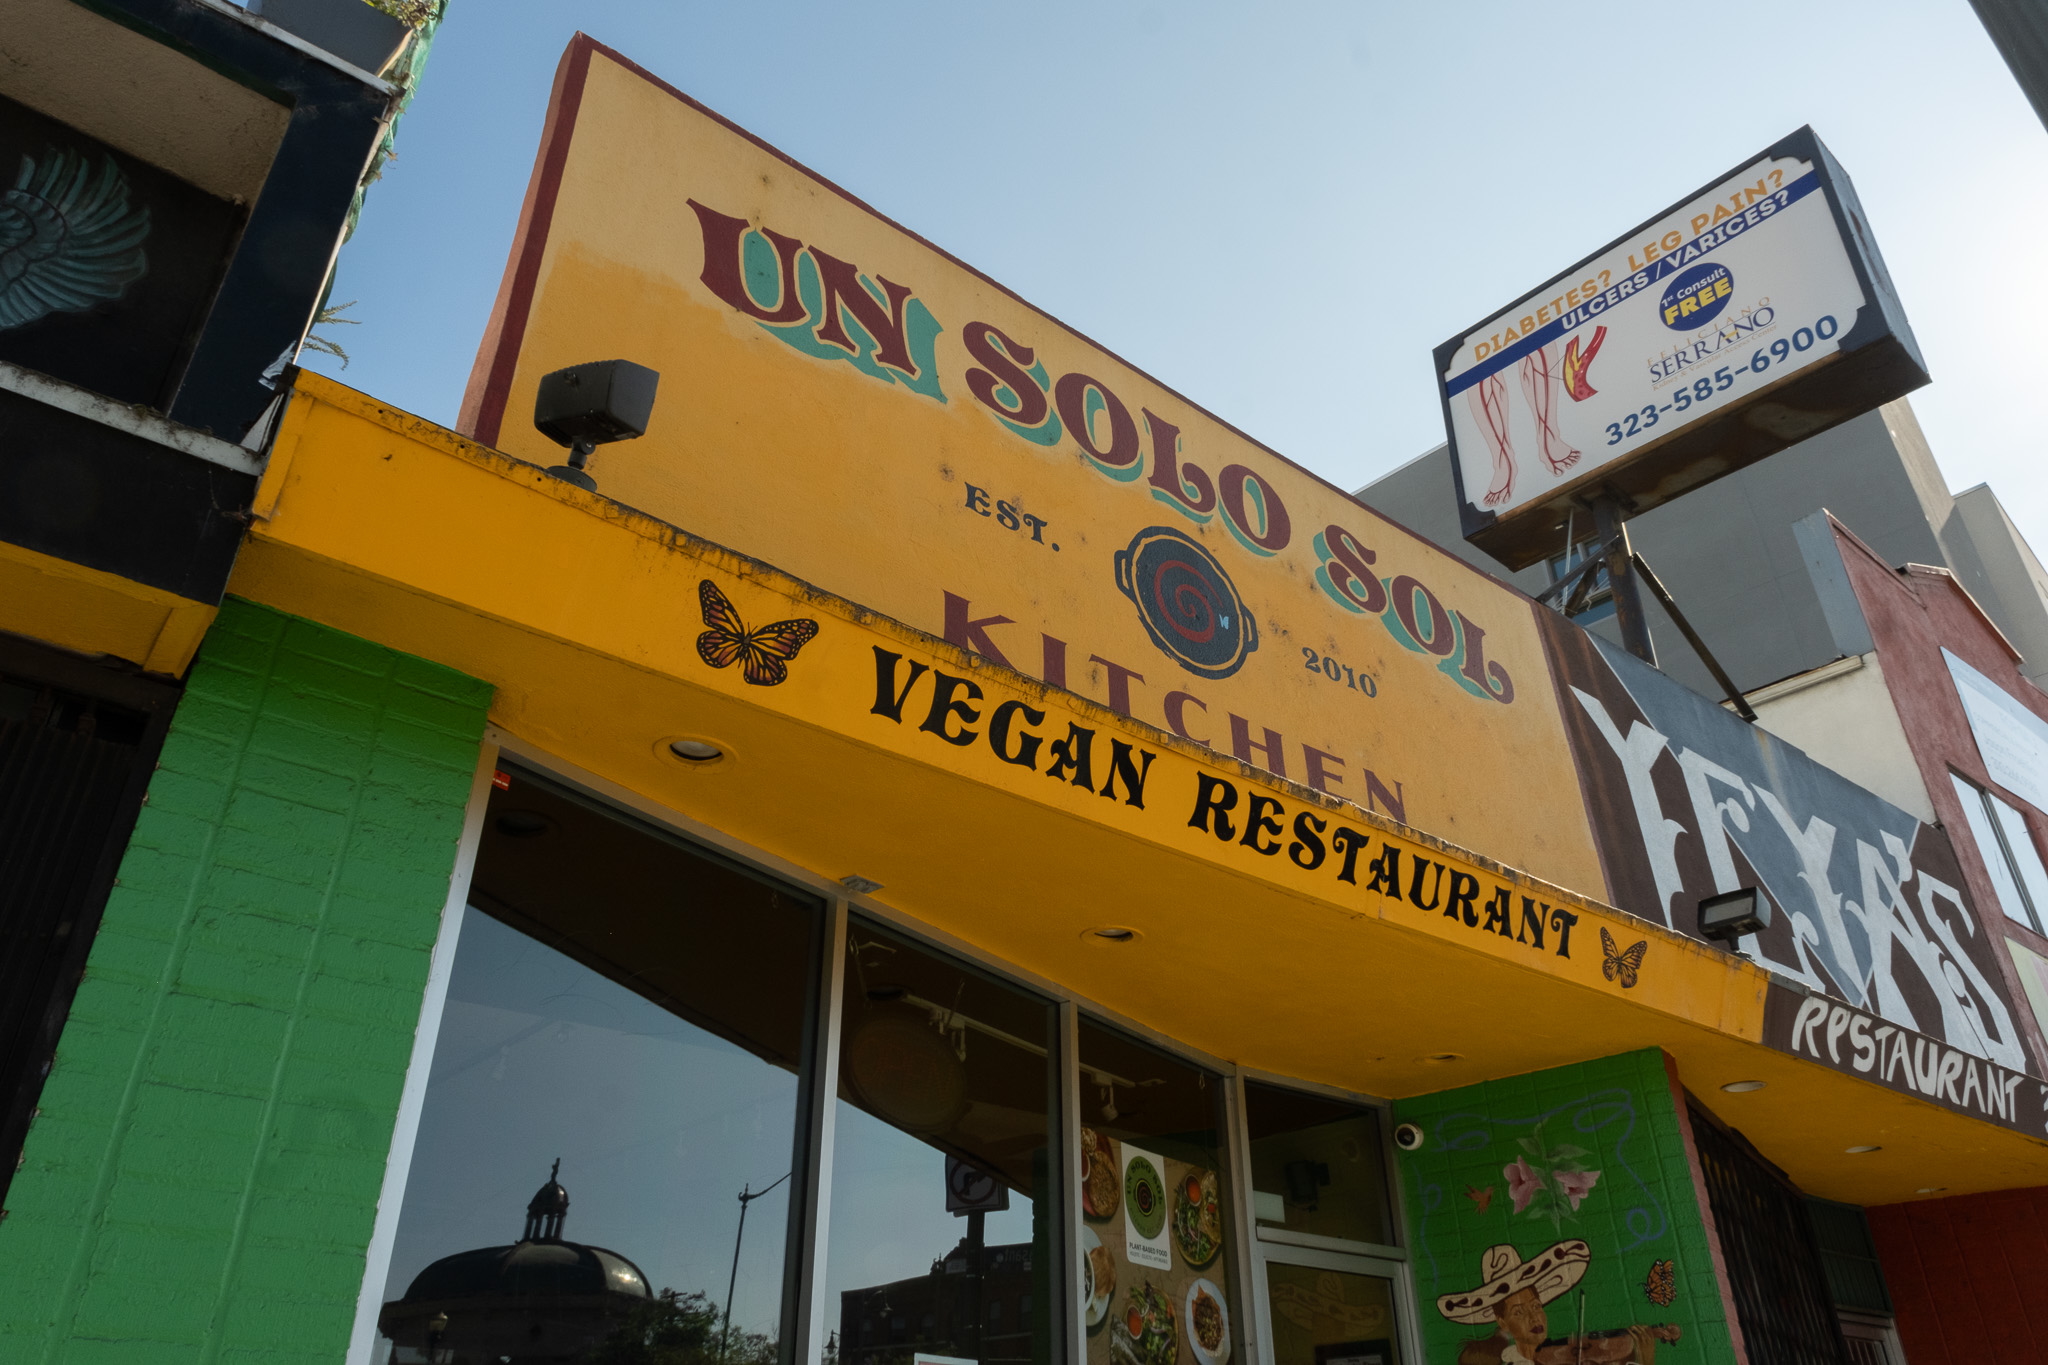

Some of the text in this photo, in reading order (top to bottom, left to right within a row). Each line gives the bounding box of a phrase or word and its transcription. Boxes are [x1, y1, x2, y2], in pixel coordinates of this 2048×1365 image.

[1474, 169, 1784, 362] DIABETES? LEG PAIN?
[1664, 277, 1733, 326] FREE
[1676, 267, 1727, 300] Consult
[1647, 296, 1771, 367] FELICIANO
[1650, 306, 1775, 384] SERRANO
[1653, 375, 1679, 391] Kidney
[1689, 354, 1721, 372] Vascular
[1724, 339, 1751, 355] Access
[1751, 324, 1777, 339] Center
[1605, 314, 1839, 446] 323-585-6900
[686, 197, 1515, 704] UN SOLO SOL
[964, 481, 1060, 553] EST.
[942, 589, 1408, 826] KITCHEN
[1300, 646, 1378, 699] 2010
[869, 644, 1580, 960] VEGAN RESTAURANT
[1156, 1246, 1168, 1257] FOOD
